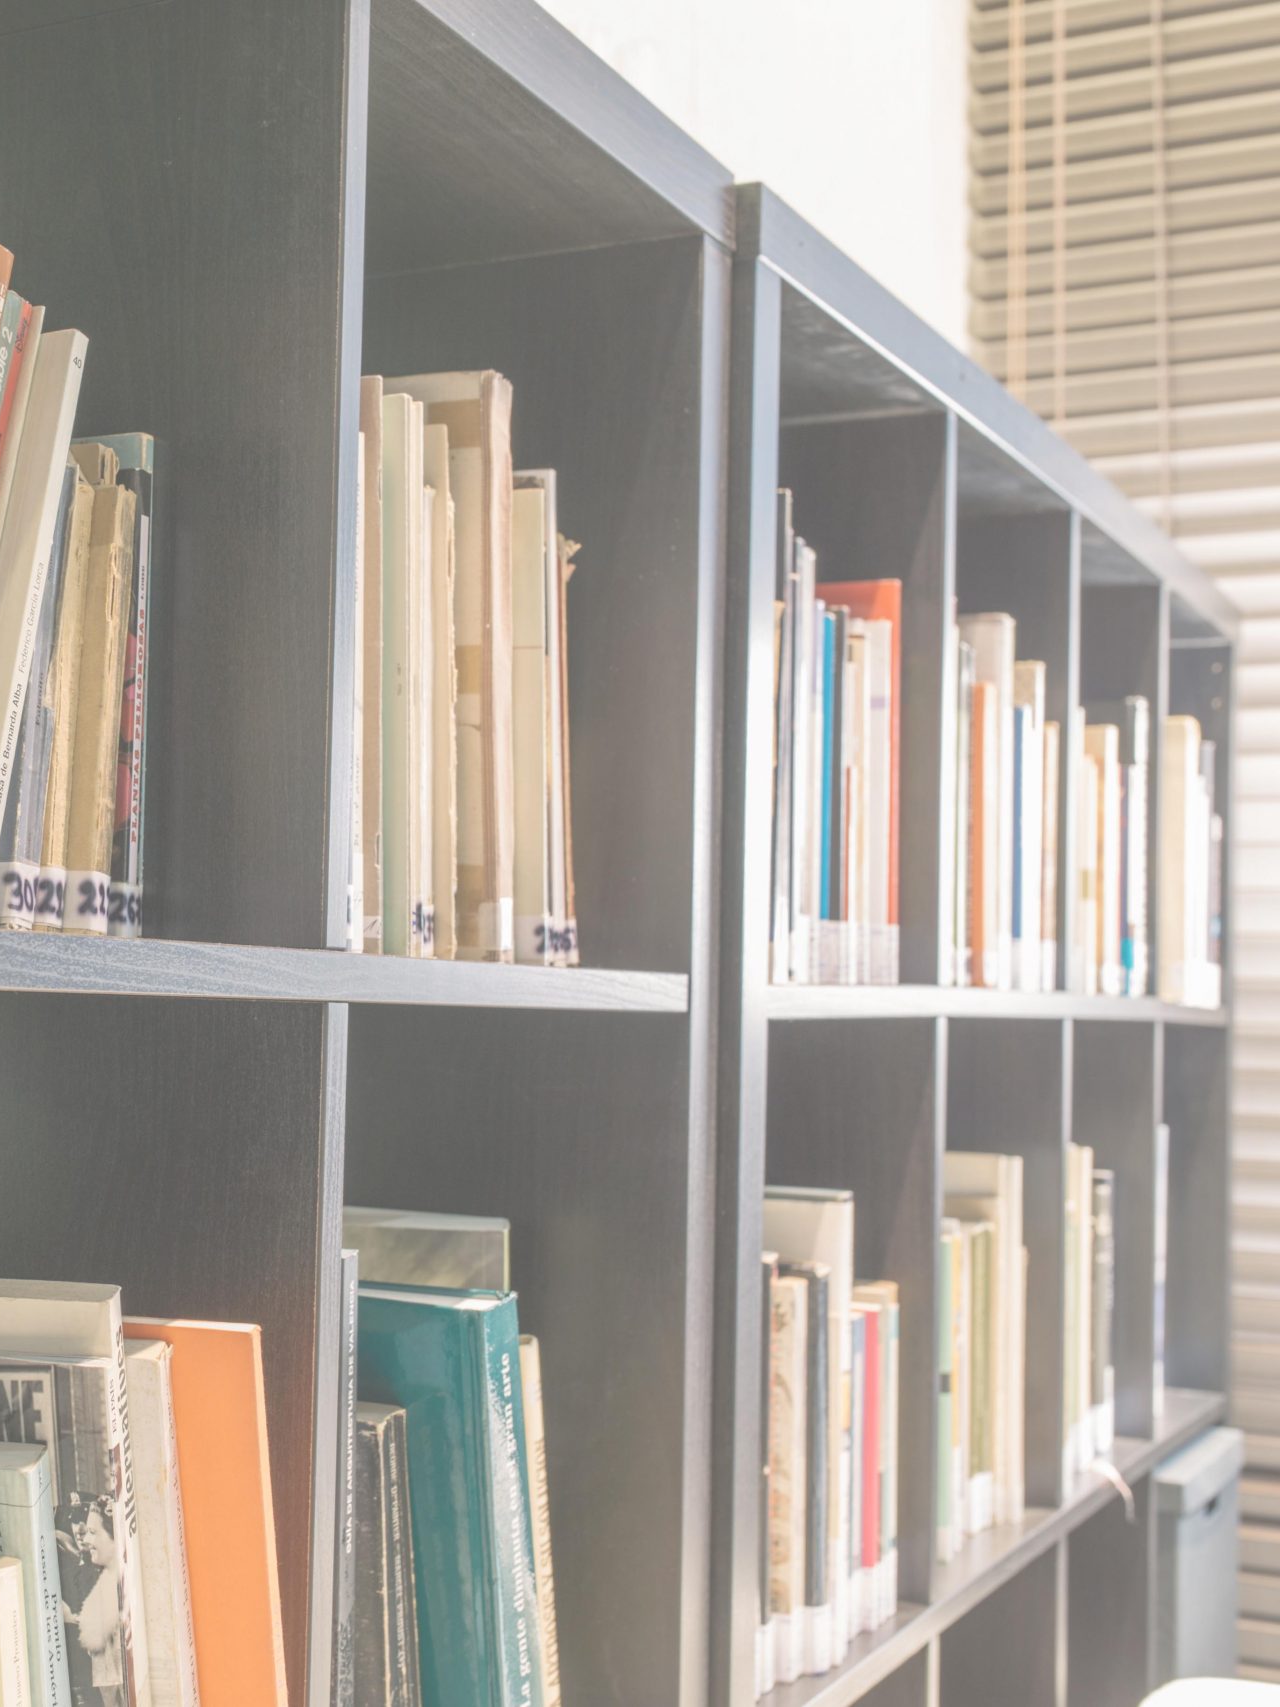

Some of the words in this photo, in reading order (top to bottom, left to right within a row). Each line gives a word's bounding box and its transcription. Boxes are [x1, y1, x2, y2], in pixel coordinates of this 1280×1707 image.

[1, 326, 12, 341] 2
[72, 356, 82, 369] 40
[34, 562, 45, 591] Lorca
[19, 631, 32, 673] Federico
[135, 608, 145, 740] PELIGROSAS
[12, 683, 23, 707] Alba
[3, 711, 18, 759] Bernarda
[0, 762, 8, 776] de
[131, 750, 140, 842] PLANTAS
[501, 1353, 512, 1397] arte
[115, 1324, 137, 1538] alternatives
[347, 1379, 355, 1490] ARQUITECTURA
[504, 1404, 517, 1454] gran
[508, 1486, 517, 1508] en
[511, 1516, 524, 1611] diminuta
[51, 1593, 61, 1662] Premio
[517, 1619, 531, 1676] gente
